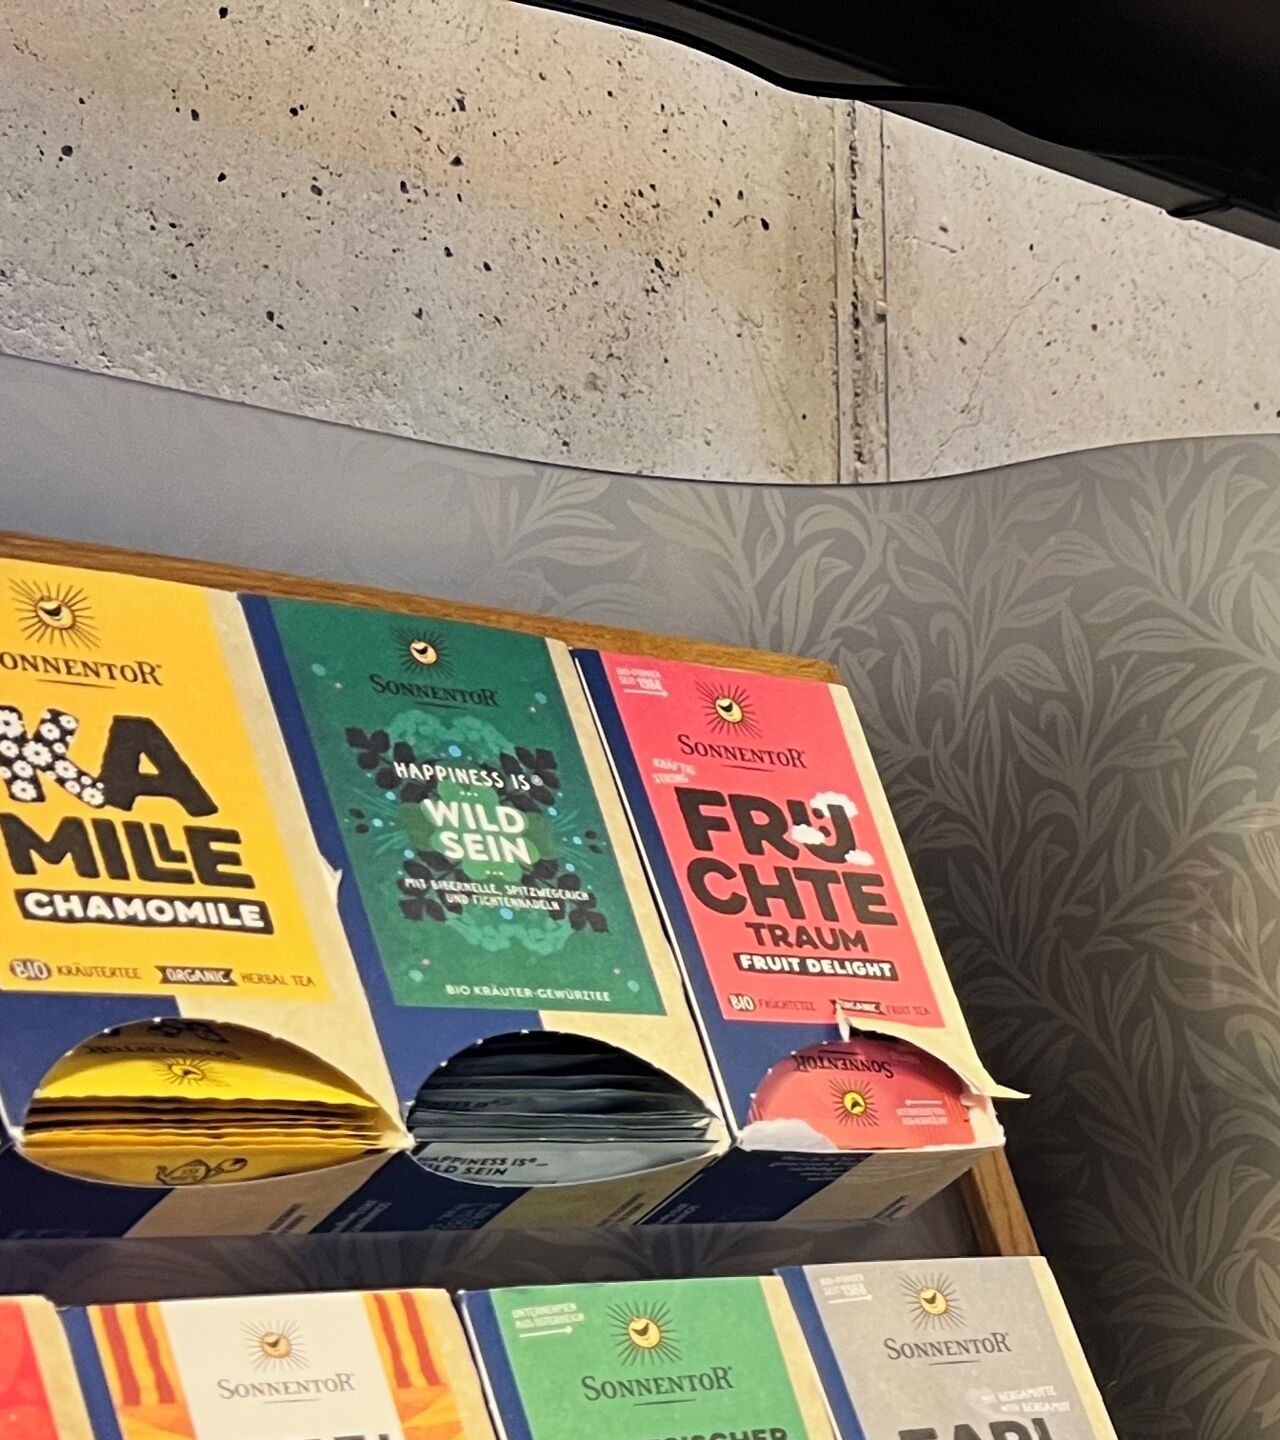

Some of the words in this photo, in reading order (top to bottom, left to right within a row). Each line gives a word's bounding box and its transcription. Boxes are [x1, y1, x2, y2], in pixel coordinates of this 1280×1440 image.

[0, 651, 163, 686] ONNENTOR
[370, 673, 499, 707] SONNENTOR
[677, 734, 808, 769] SONNENTOR
[393, 761, 504, 789] HAPPINESS
[423, 798, 526, 834] WILD
[0, 812, 256, 889] MILLE
[439, 829, 532, 865] SEIN
[404, 878, 426, 890] MIT
[446, 893, 469, 905] UND
[687, 857, 898, 926] CHTE
[23, 891, 265, 928] CHAMOMILE
[745, 921, 869, 953] TRAUM
[12, 960, 49, 981] BIO
[56, 962, 142, 980] KRÄUTERTEE
[164, 968, 230, 984] ORGANIC
[240, 972, 287, 986] HERBAL
[290, 974, 316, 988] TEA
[739, 954, 801, 972] FRUIT
[807, 957, 892, 978] DELIGHT
[445, 984, 471, 996] BIO
[729, 993, 755, 1012] BIO
[913, 1006, 930, 1016] TEA
[463, 1166, 508, 1177] SEIN
[884, 1332, 1012, 1360] SONNENTOR
[217, 1373, 356, 1400] SONNENTOR
[581, 1366, 735, 1401] SONNENTOR
